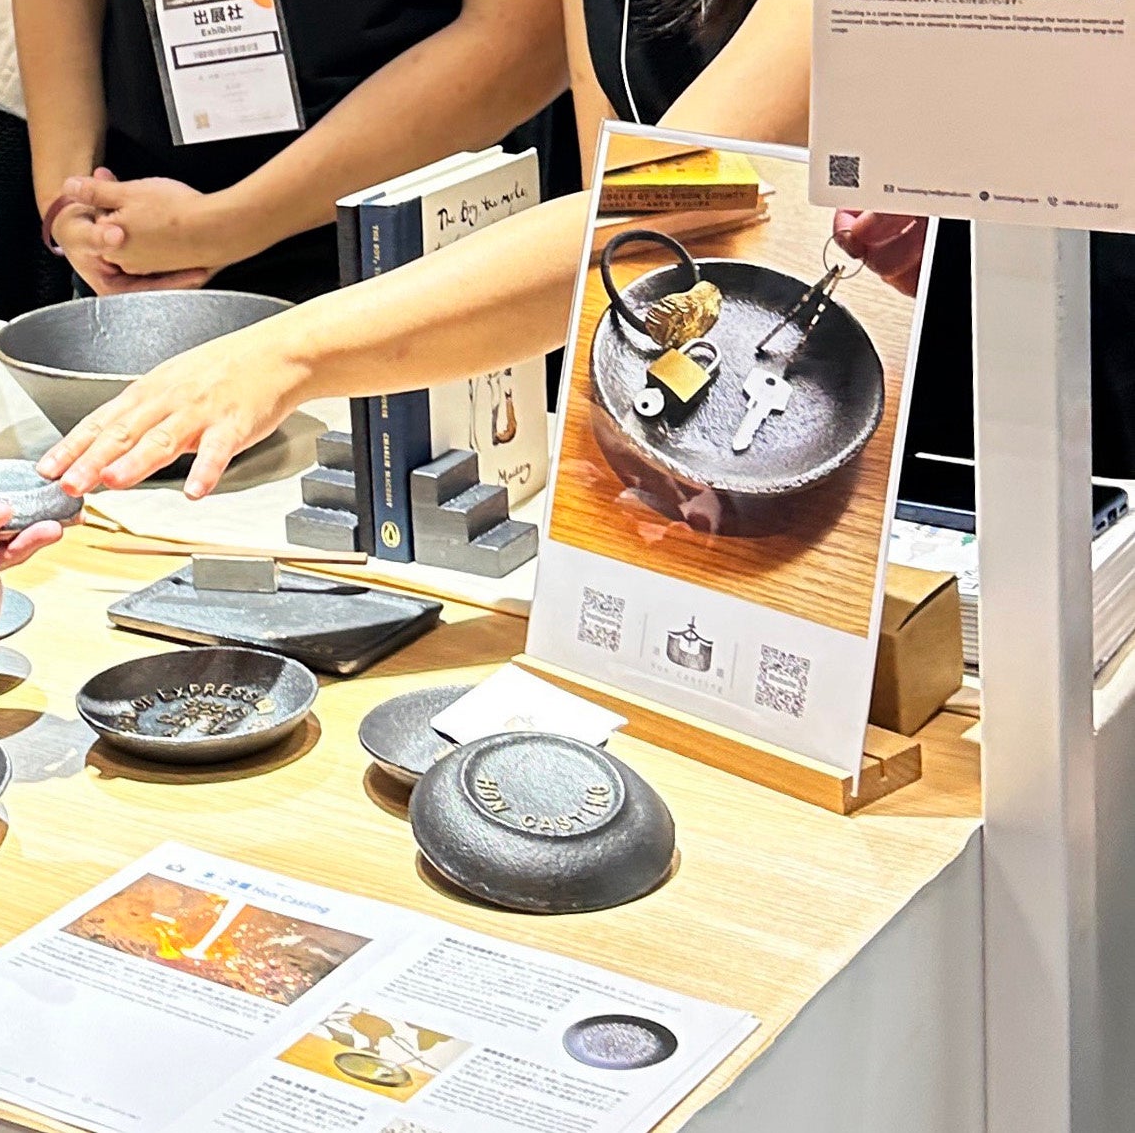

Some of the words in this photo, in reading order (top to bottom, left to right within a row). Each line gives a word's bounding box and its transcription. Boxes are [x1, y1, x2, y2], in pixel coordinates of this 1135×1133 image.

[193, 3, 244, 26] 出展社
[200, 23, 243, 37] Exhibitor
[436, 207, 456, 231] The
[474, 777, 511, 814] HON
[520, 782, 612, 832] CASTING
